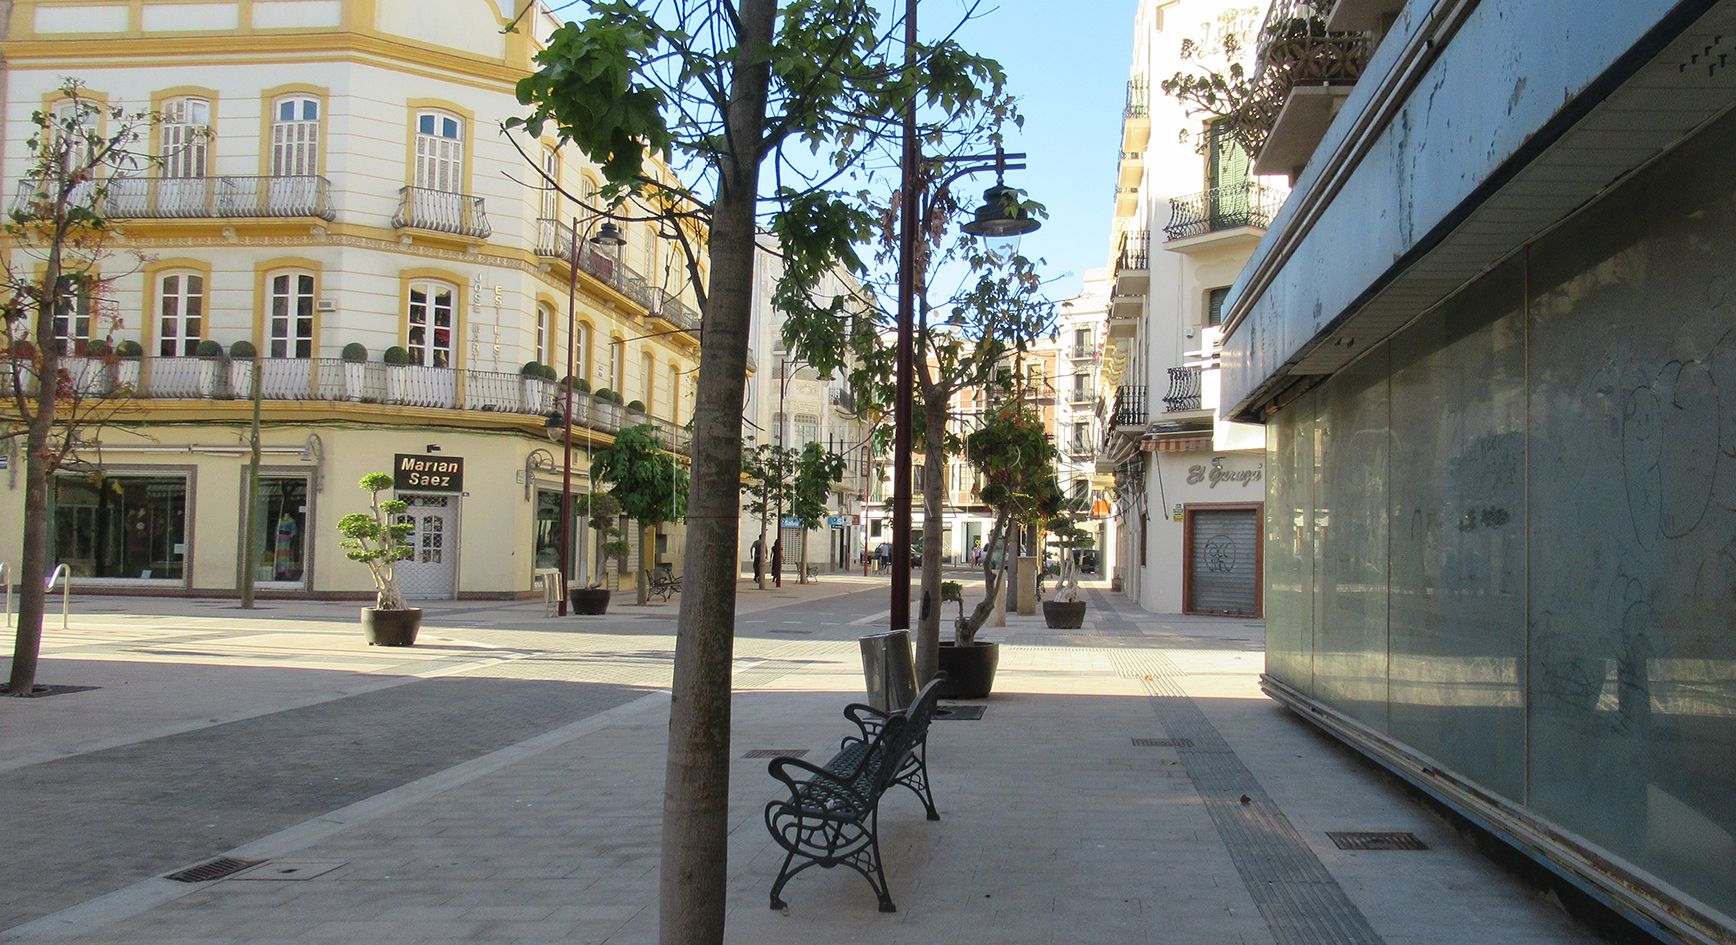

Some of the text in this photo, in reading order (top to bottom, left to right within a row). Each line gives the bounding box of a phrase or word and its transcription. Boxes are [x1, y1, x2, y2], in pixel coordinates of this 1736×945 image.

[473, 273, 482, 313] JOSE
[401, 458, 458, 472] Marian
[409, 473, 450, 486] Saez
[1186, 464, 1206, 485] El
